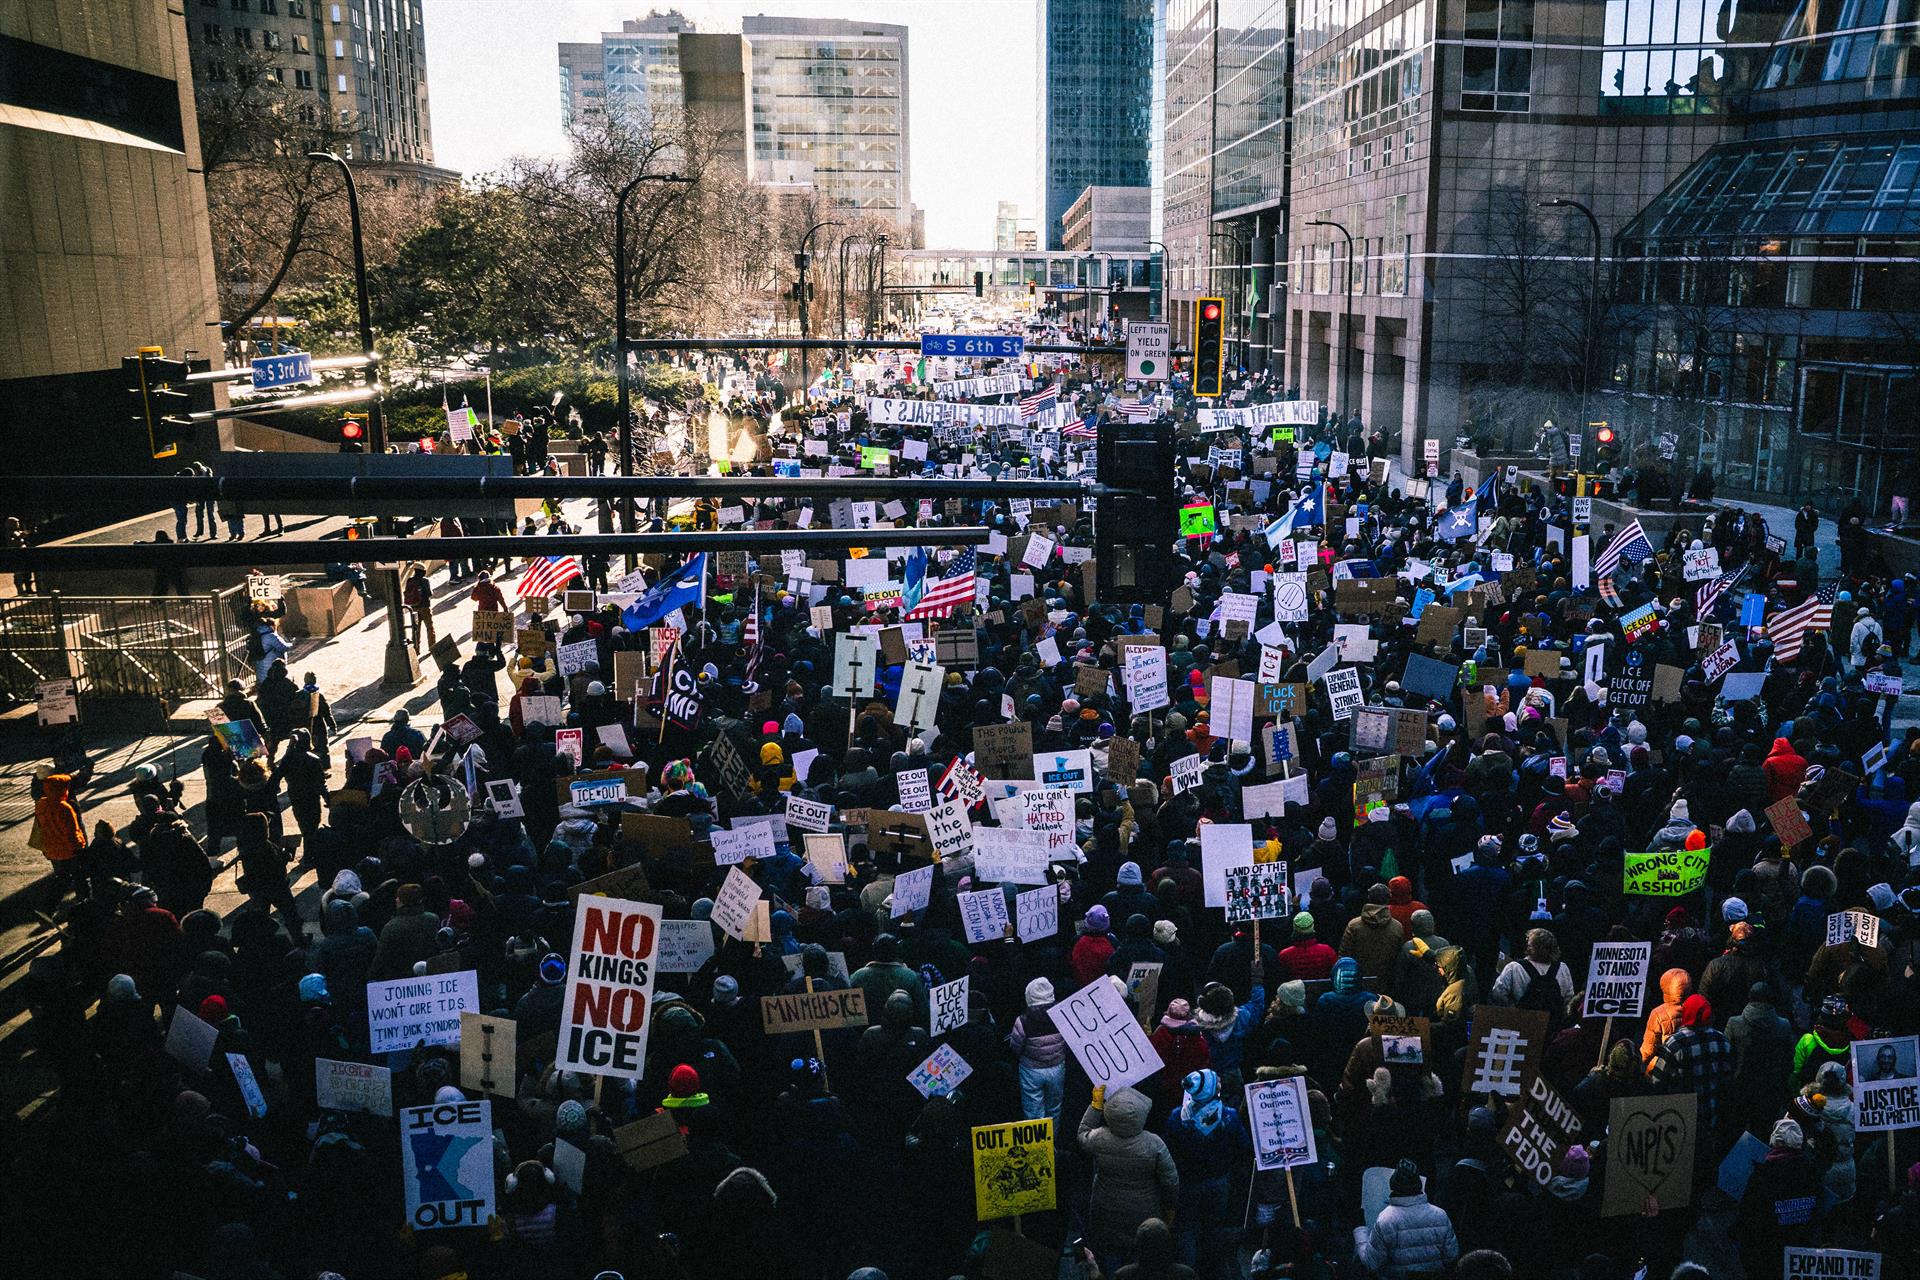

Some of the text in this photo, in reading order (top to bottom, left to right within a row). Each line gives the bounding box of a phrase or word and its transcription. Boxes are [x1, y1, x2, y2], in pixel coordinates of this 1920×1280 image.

[1130, 326, 1168, 334] LEFT TURN
[946, 340, 1020, 353] S 6th St
[1137, 338, 1160, 347] YIELD
[1130, 349, 1166, 357] ON GREEN
[267, 360, 310, 381] S 3rd Av
[1018, 469, 1030, 479] STOP
[854, 503, 869, 512] FUCK
[1574, 498, 1589, 506] ONE
[1684, 550, 1708, 561] WE DO
[252, 588, 270, 598] ICE
[865, 589, 901, 601] ICE OUT
[475, 611, 497, 620] STAY
[1623, 612, 1655, 634] ICE OUT
[475, 621, 512, 630] STRONG
[1700, 623, 1720, 634] ICE
[475, 631, 492, 641] MN
[1699, 634, 1719, 647] OUT
[1702, 643, 1733, 669] CHINGA
[1714, 657, 1725, 667] LA
[564, 664, 577, 674] NO
[1133, 669, 1157, 683] CUCK
[1327, 670, 1356, 683] EXPAND THE
[1622, 666, 1642, 677] ICE
[1709, 656, 1737, 680] MIGRA
[1329, 678, 1359, 694] GENERAL
[1610, 677, 1652, 692] FUCK OFF
[1334, 692, 1361, 709] STRIKE!
[1609, 691, 1648, 705] GET OUT
[977, 725, 1026, 738] THE POWER
[1003, 735, 1017, 744] THE
[1185, 756, 1199, 772] OUT
[898, 771, 927, 782] ICE OUT
[1048, 771, 1078, 782] ICE OUT
[1177, 771, 1199, 791] NOW
[577, 785, 621, 802] ICE OUT
[900, 785, 928, 795] ICE OUT
[959, 787, 979, 800] PLACE
[1046, 789, 1071, 801] can't
[788, 802, 804, 814] ICE
[806, 807, 828, 820] OUT
[902, 800, 930, 810] ICE OUT
[1031, 800, 1054, 813] spell
[795, 815, 826, 826] MINNESOTA
[1025, 811, 1065, 825] HATRED
[1031, 822, 1063, 831] without
[933, 819, 962, 836] the
[714, 830, 768, 847] Donald Trump
[934, 829, 972, 849] people
[1048, 829, 1073, 849] HAT!
[721, 846, 771, 863] PEDOPHILE
[1225, 862, 1287, 878] LAND OF THE
[1626, 853, 1709, 879] WRONG CITY
[1628, 874, 1705, 893] ASSHOLES!
[990, 892, 1007, 920] NOBODY
[963, 895, 986, 942] STOLEN LAND
[1829, 914, 1837, 931] OUT
[1843, 912, 1853, 942] ICE OUT
[581, 907, 655, 960] NO
[1860, 914, 1871, 944] ICE OUT
[1594, 947, 1647, 961] MINNESOTA
[578, 953, 648, 987] KINGS
[1597, 961, 1640, 976] STANDS
[385, 979, 459, 1002] JOINING ICE
[936, 979, 965, 1004] FUCK
[1588, 981, 1642, 999] AGAINST
[371, 1002, 406, 1021] WON'T
[409, 1001, 433, 1016] CURE
[571, 983, 646, 1033] NO
[765, 993, 865, 1024] MN ICE
[937, 996, 962, 1017] ICE
[1060, 986, 1119, 1038] ICE
[1586, 999, 1639, 1015] ICE
[935, 1008, 965, 1032] ACAB
[1372, 1016, 1415, 1026] AMERICA
[375, 1024, 422, 1041] TINY DICK
[567, 1027, 641, 1071] ICE
[1084, 1022, 1145, 1081] OUT
[917, 1053, 950, 1083] ICE
[1529, 1076, 1583, 1134] DUMP
[1859, 1085, 1918, 1112] JUSTICE
[409, 1103, 482, 1129] ICE
[1859, 1107, 1920, 1127] ALEX PRETTI
[975, 1123, 1051, 1151] OUT. NOW.
[1519, 1108, 1557, 1159] THE
[1504, 1126, 1552, 1185] PEDO
[1626, 1124, 1679, 1177] MPLS
[414, 1199, 486, 1228] OUT
[1789, 1254, 1874, 1276] EXPAND THE
